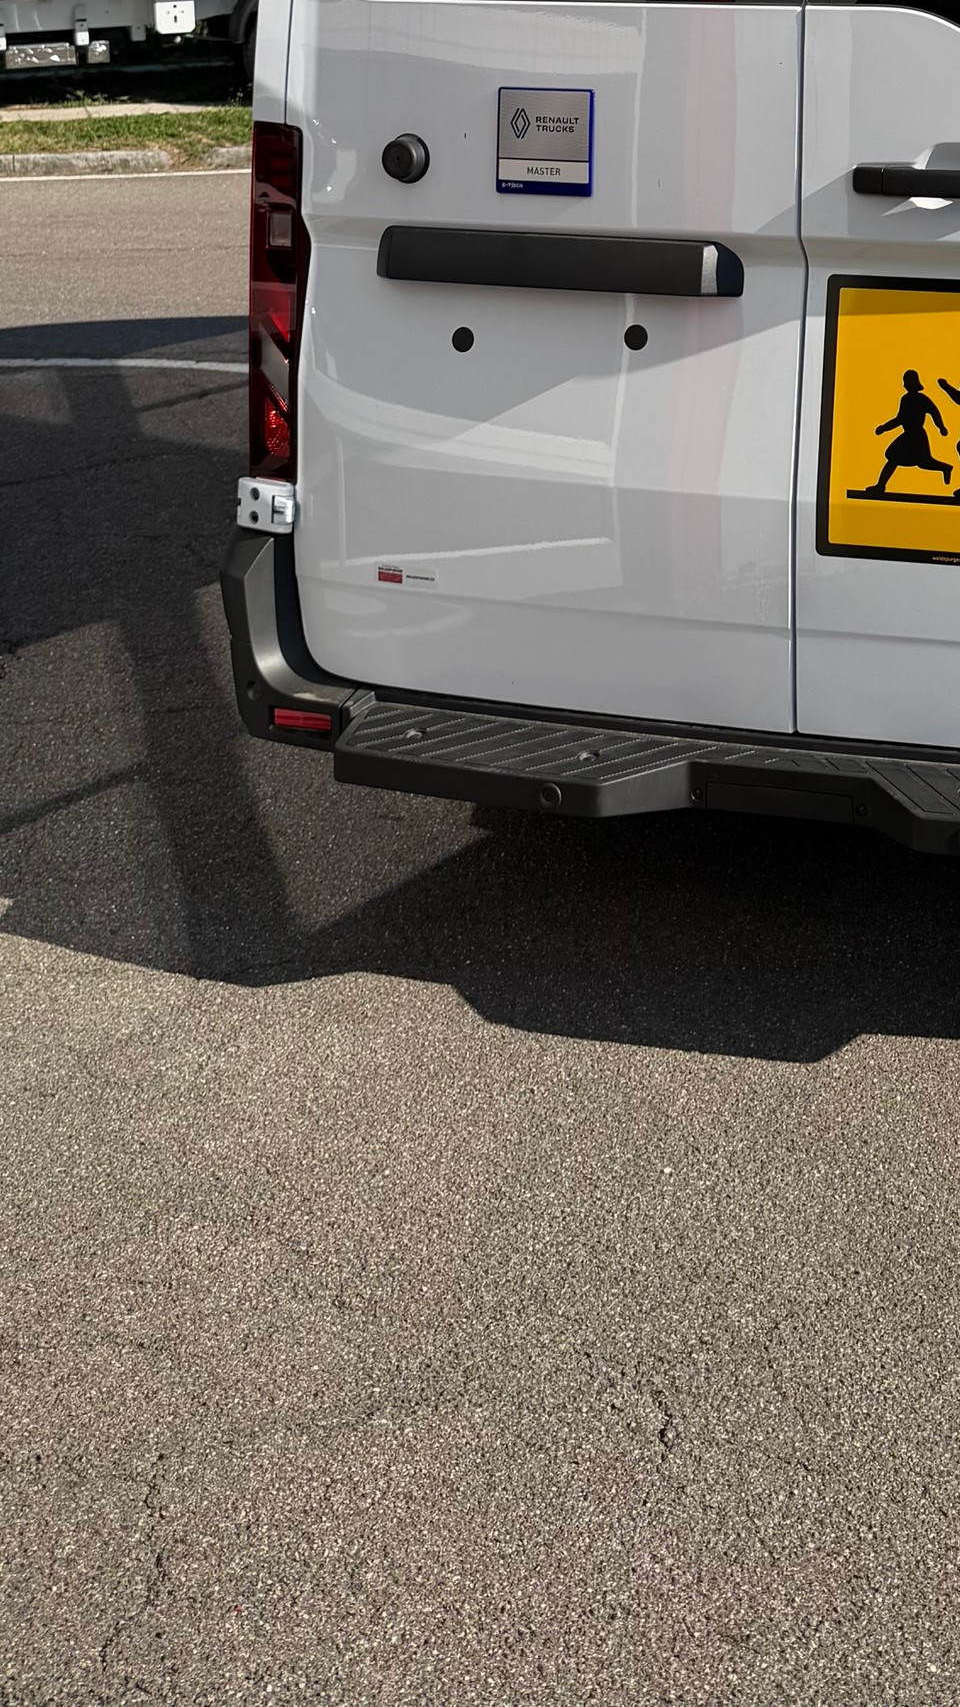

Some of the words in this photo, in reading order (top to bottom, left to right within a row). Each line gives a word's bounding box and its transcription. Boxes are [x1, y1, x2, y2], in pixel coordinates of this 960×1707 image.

[535, 116, 580, 125] RENAULT
[536, 125, 575, 133] TRUCKS
[527, 166, 561, 176] MASTER
